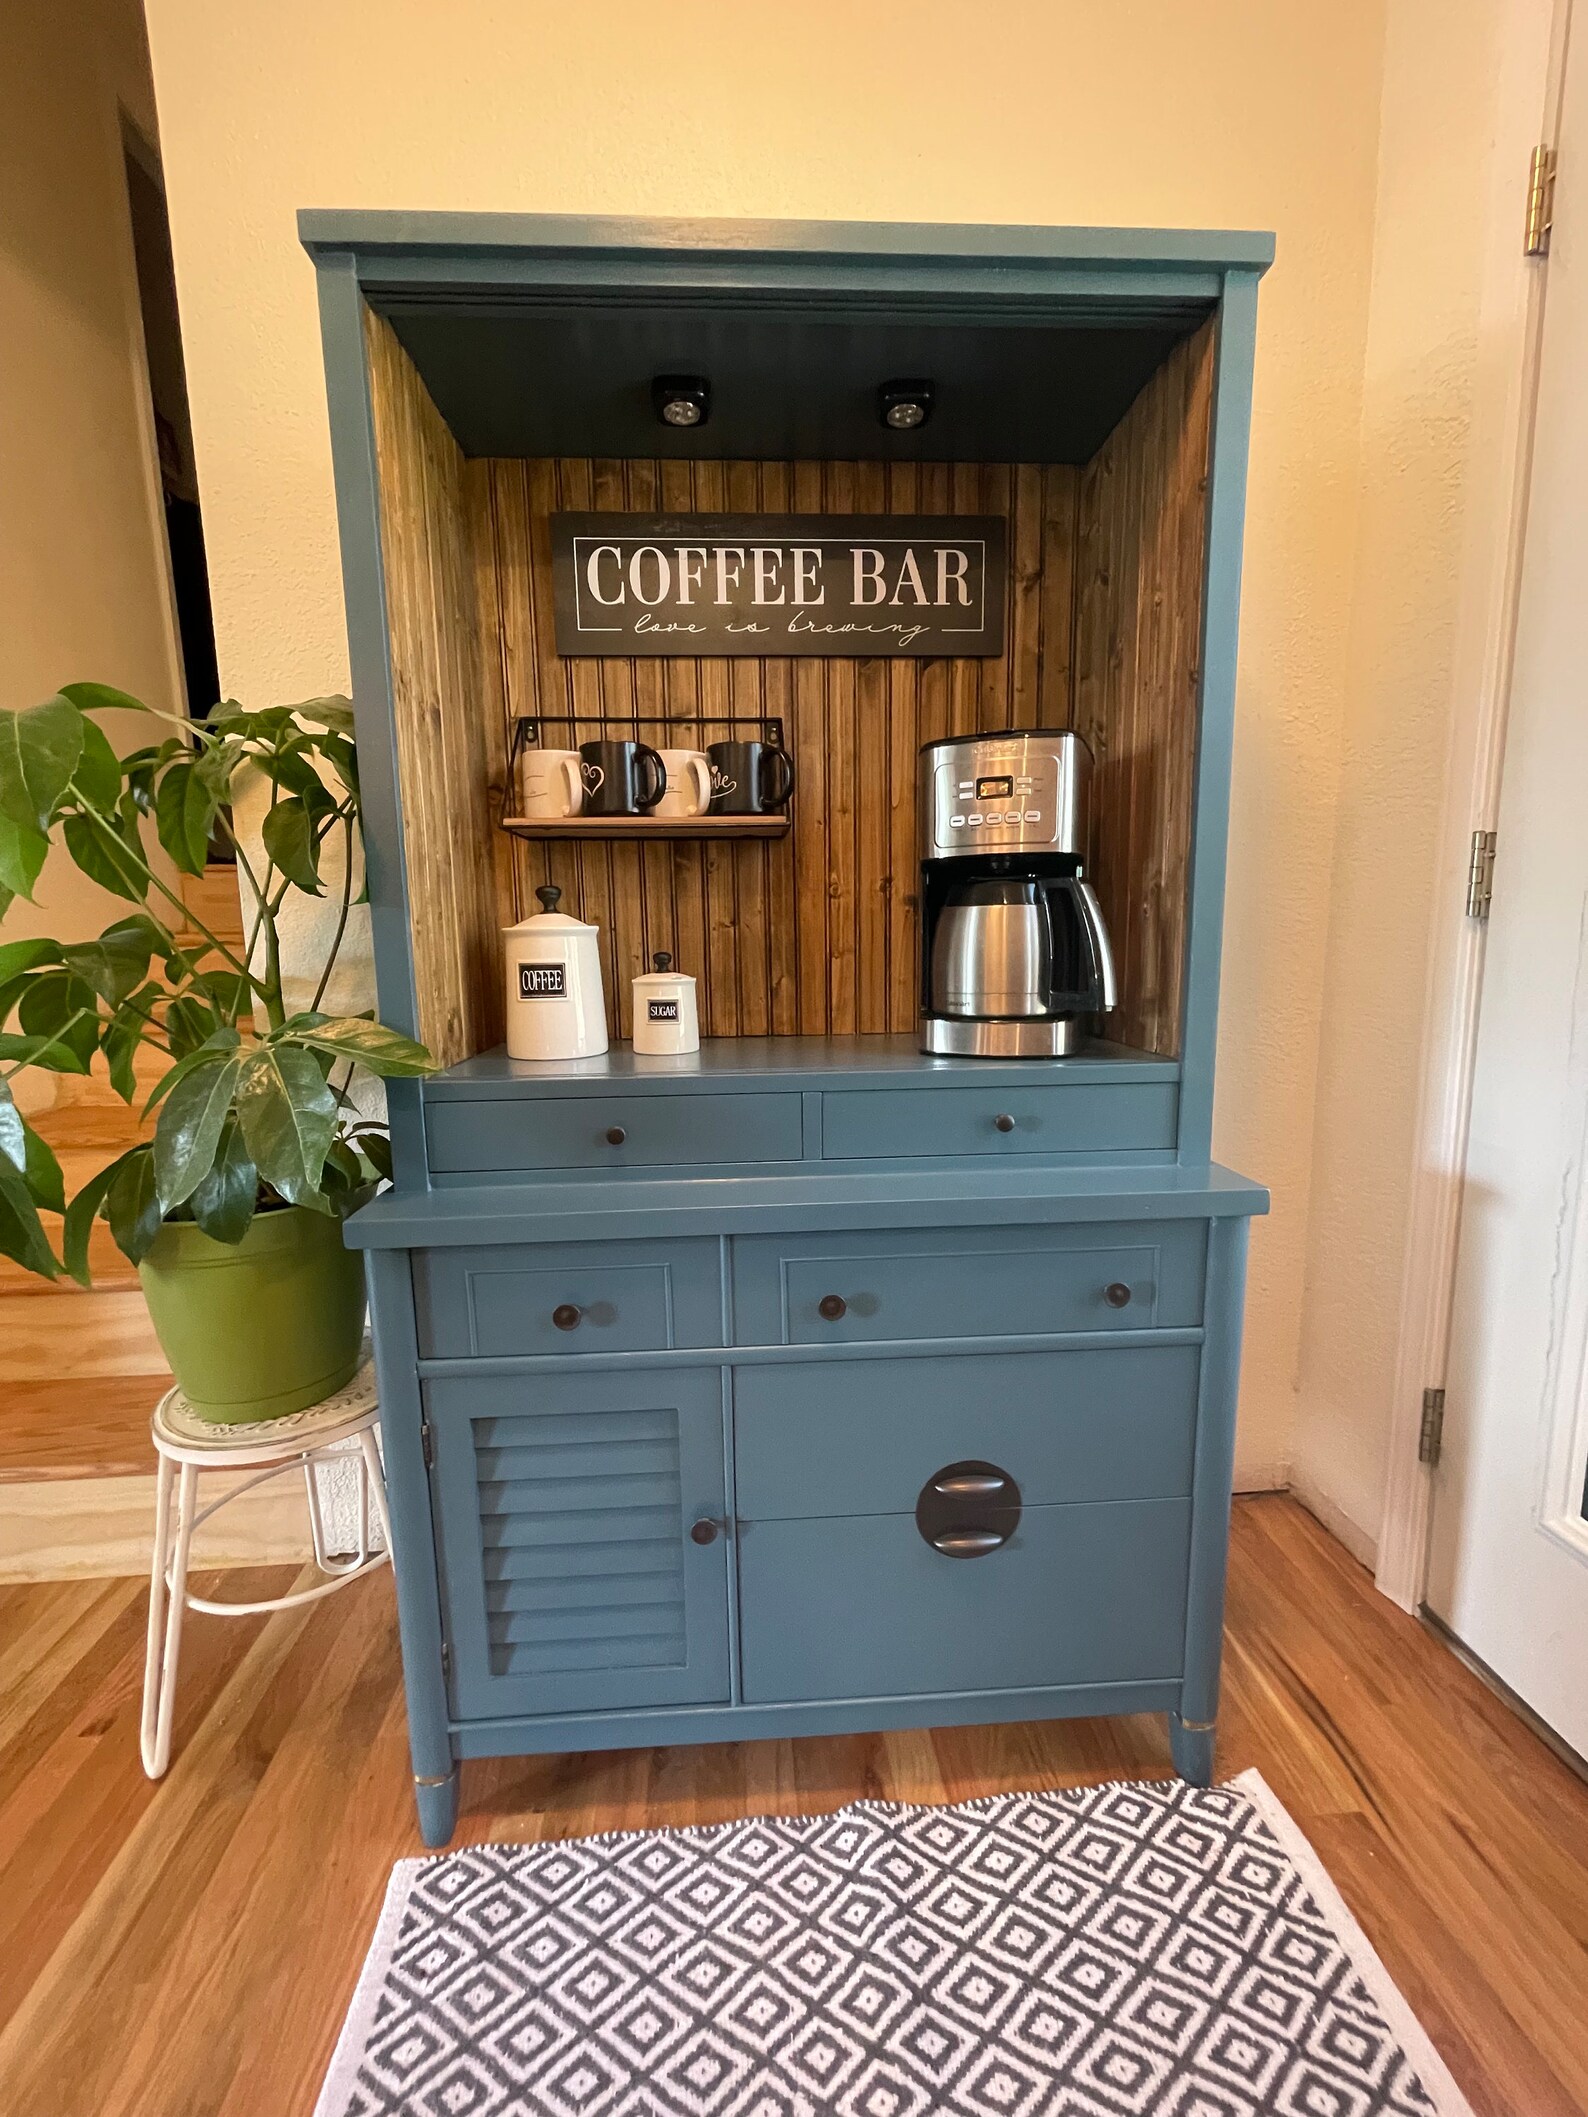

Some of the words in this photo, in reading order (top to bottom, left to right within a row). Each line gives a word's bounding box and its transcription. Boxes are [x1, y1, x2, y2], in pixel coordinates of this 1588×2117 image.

[586, 546, 825, 605] COFFEE
[849, 548, 973, 606] BAR
[634, 612, 707, 634] love
[725, 622, 770, 633] is
[788, 610, 931, 646] brewing
[522, 969, 563, 991] COFFEE
[650, 1005, 676, 1017] SUGAR
